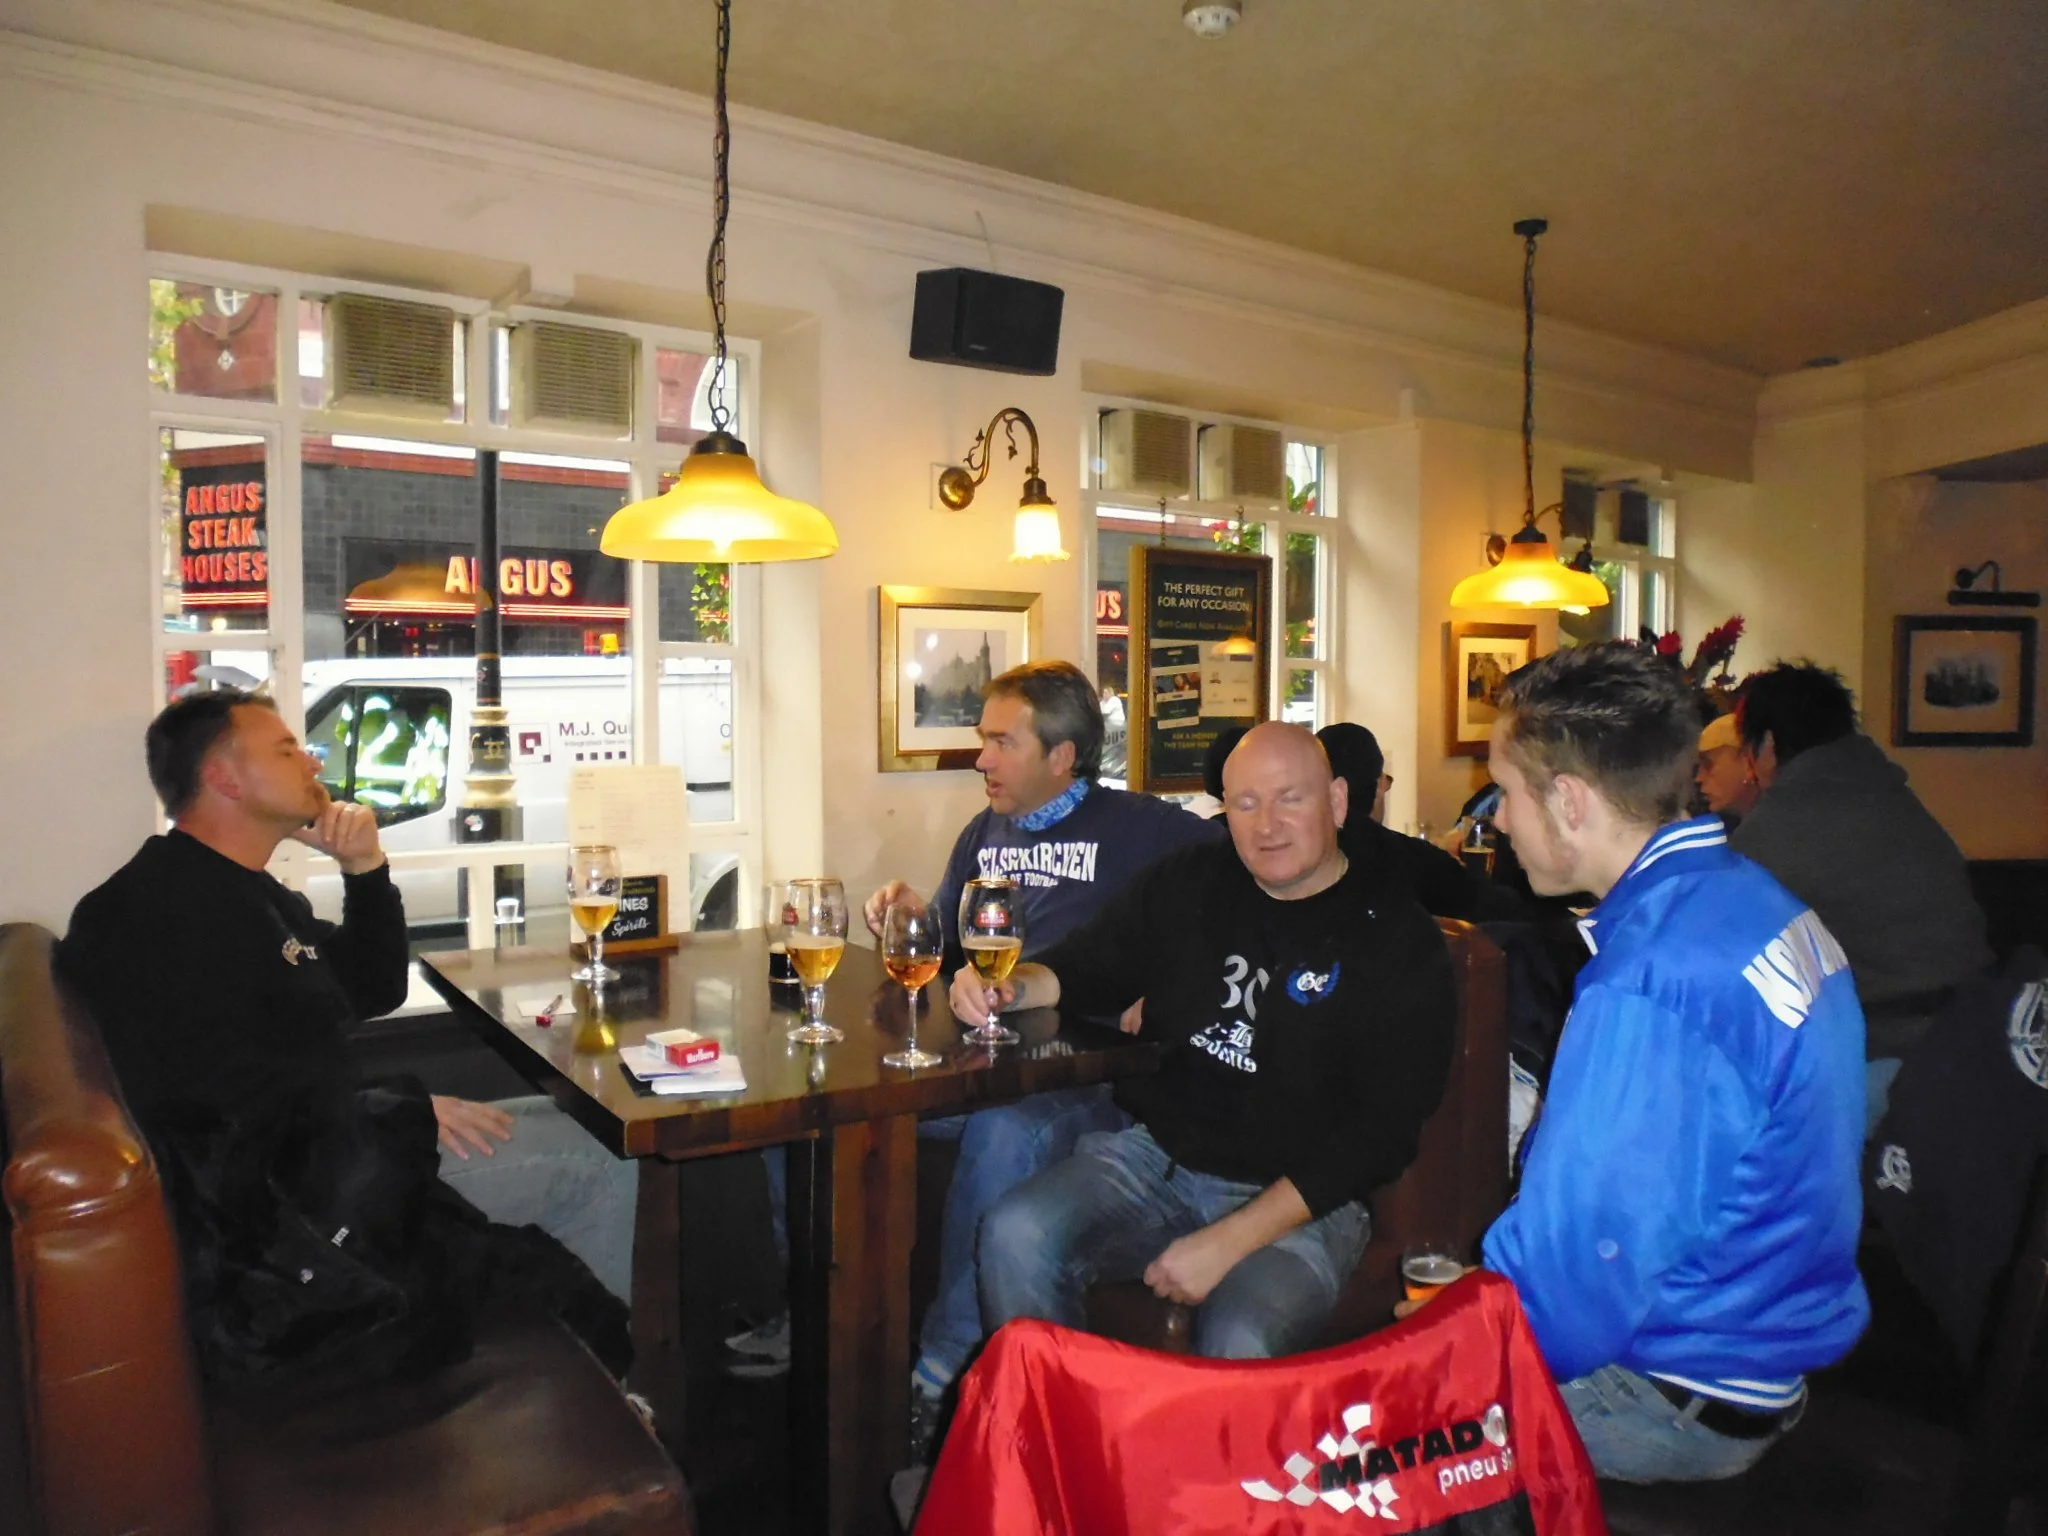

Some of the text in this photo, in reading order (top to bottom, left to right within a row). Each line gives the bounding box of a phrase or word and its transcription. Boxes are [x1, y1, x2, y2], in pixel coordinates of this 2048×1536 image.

[185, 481, 263, 515] ANGUS
[188, 517, 261, 549] STEAK
[181, 551, 268, 583] HOUSES
[1164, 582, 1245, 598] THE PERFECT GIFT
[1157, 596, 1250, 612] FOR ANY OCCASION
[559, 721, 595, 736] M.J.
[618, 897, 649, 912] INES
